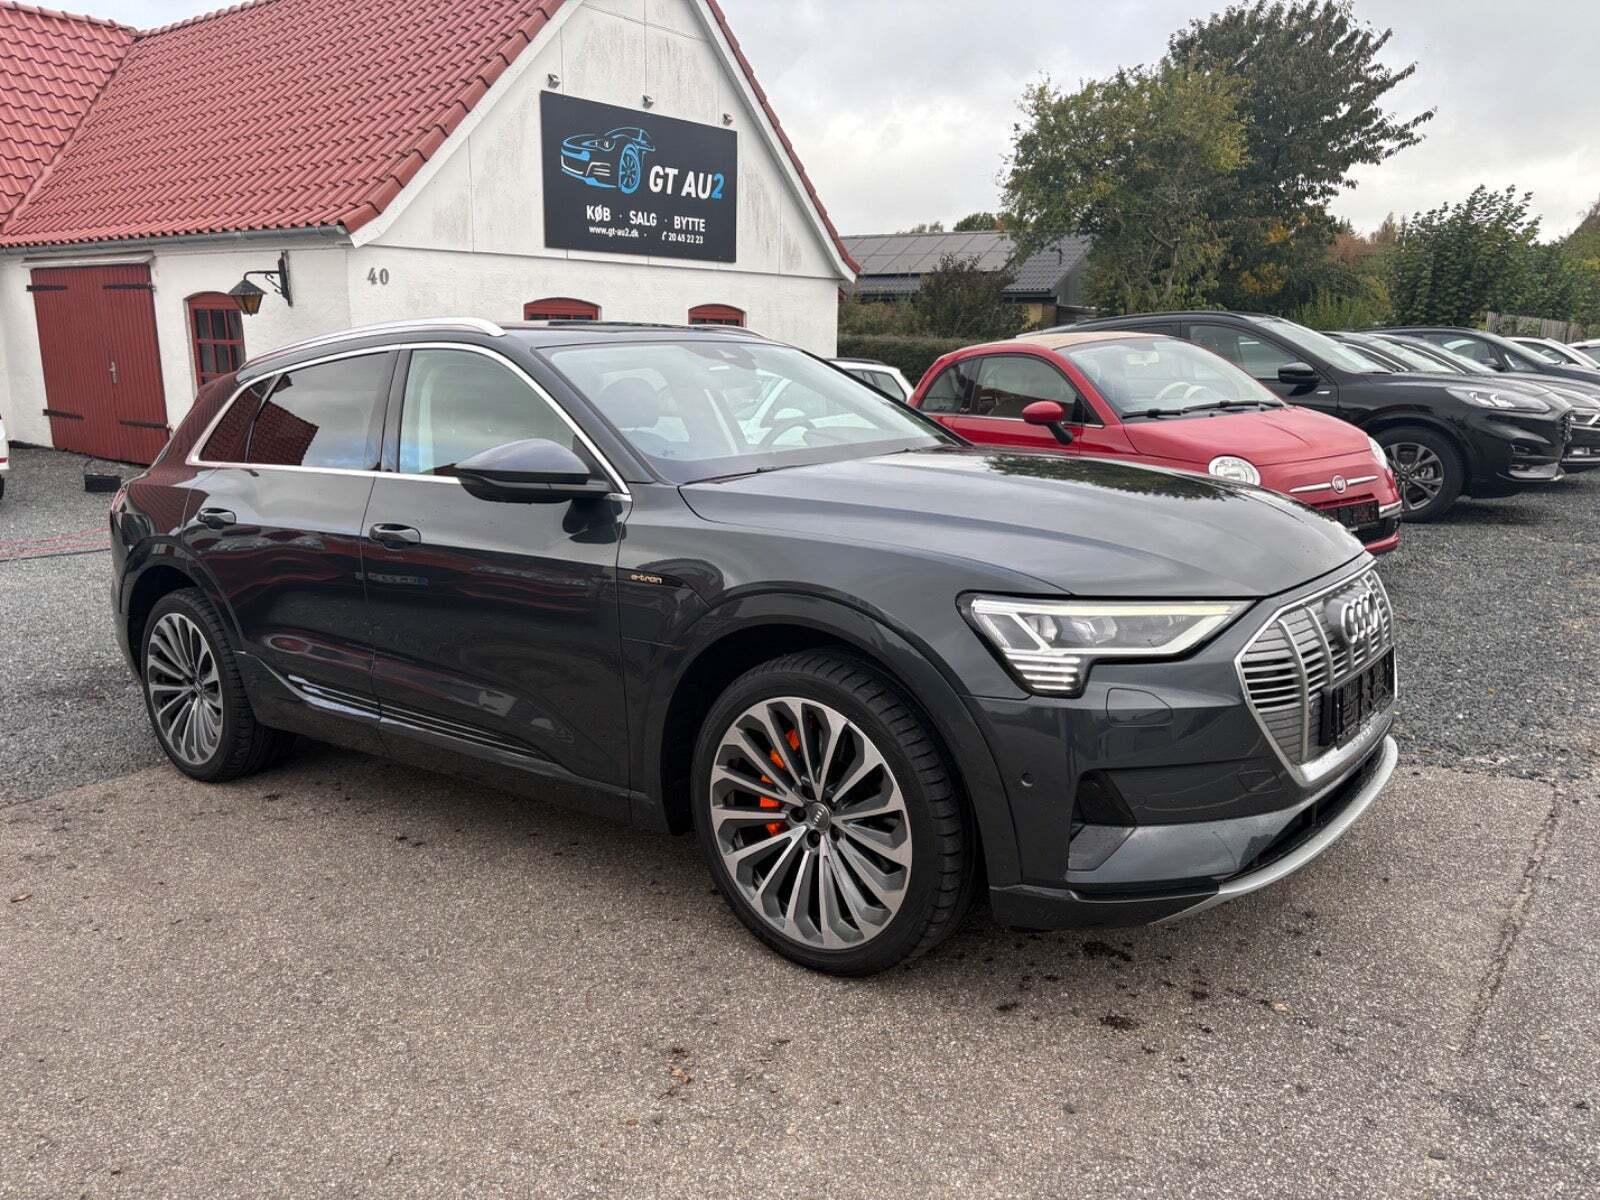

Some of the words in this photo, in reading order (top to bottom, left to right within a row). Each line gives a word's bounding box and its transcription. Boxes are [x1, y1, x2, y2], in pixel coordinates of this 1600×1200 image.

[649, 165, 679, 195] GT
[681, 171, 725, 200] AU2
[586, 204, 611, 222] KØB
[629, 210, 657, 226] SALG
[674, 215, 706, 232] BYTTE
[588, 226, 640, 238] www.gt-au2.dk
[367, 267, 390, 285] 40
[631, 574, 662, 584] e-tron
